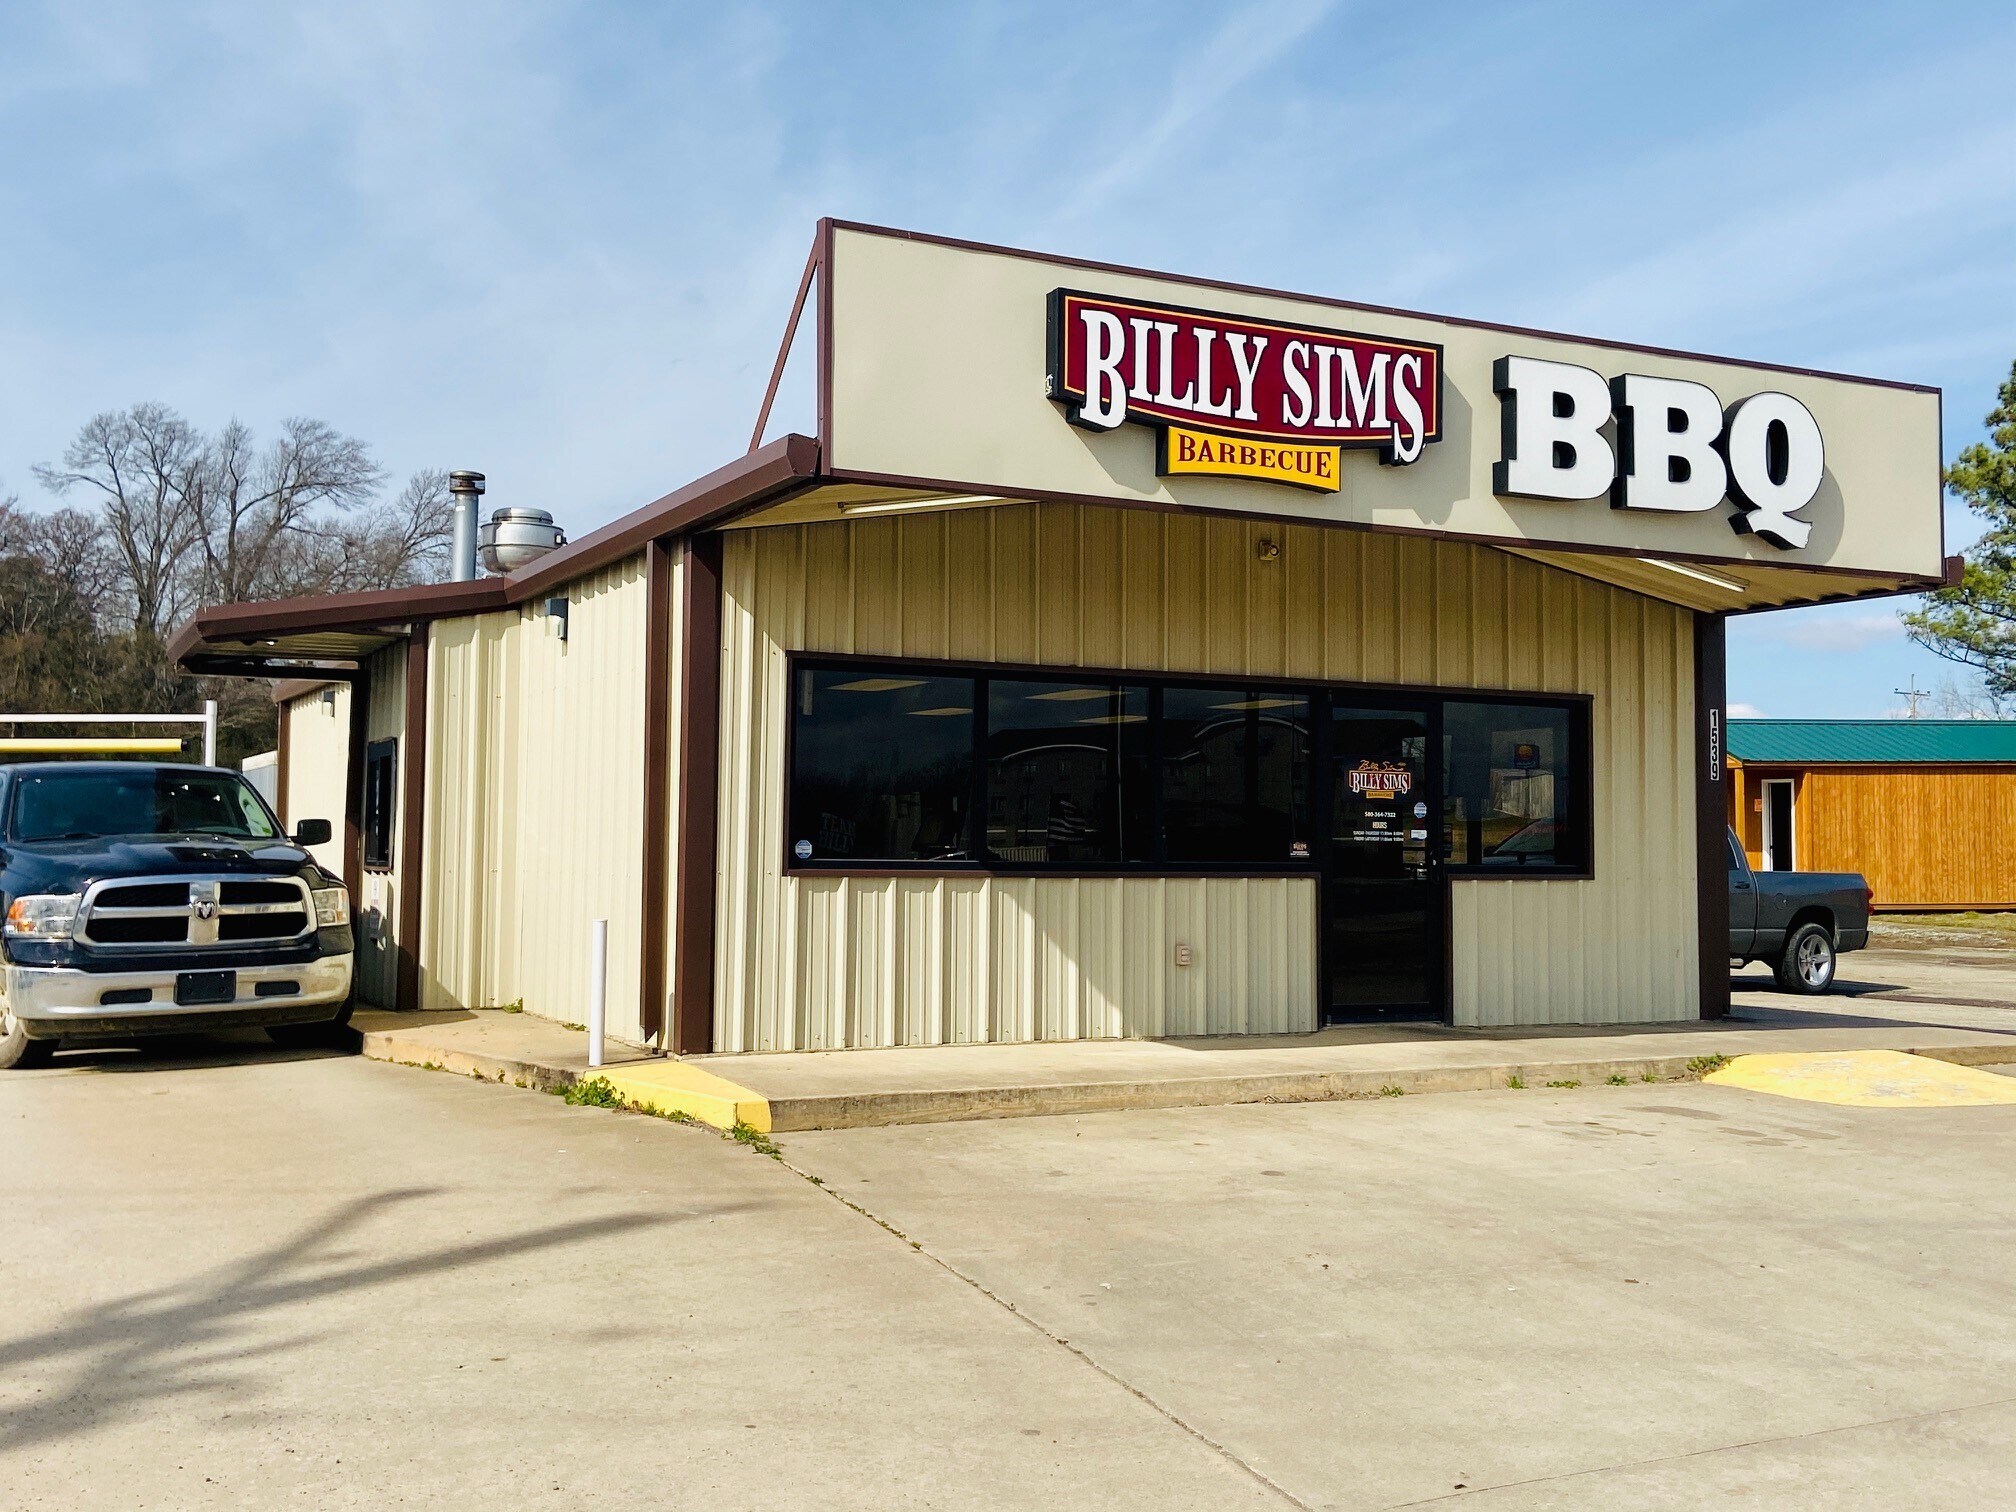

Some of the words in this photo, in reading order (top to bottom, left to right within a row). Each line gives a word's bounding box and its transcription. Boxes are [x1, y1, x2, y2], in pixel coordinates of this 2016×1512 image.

[1080, 309, 1268, 428] BILLY
[1282, 340, 1426, 463] SIMS
[1177, 434, 1332, 479] BARBECUE
[1494, 355, 1826, 549] BBQ
[1711, 711, 1719, 780] 1539
[1352, 772, 1382, 793] BILLY
[1383, 773, 1408, 794] SIMS
